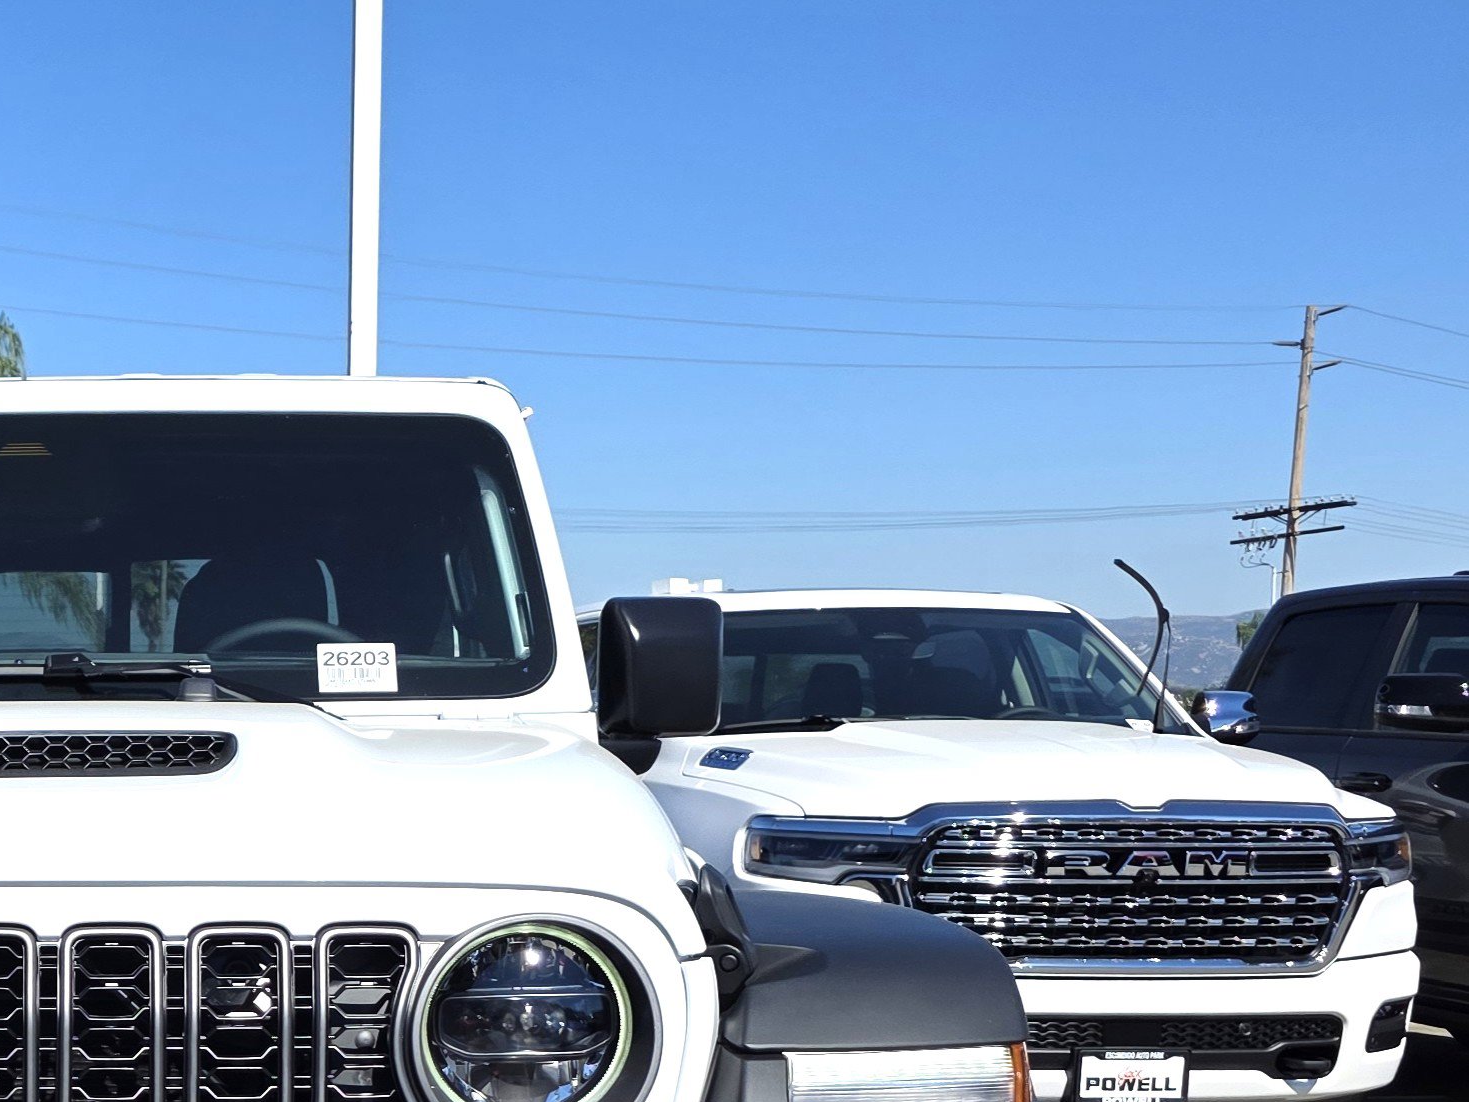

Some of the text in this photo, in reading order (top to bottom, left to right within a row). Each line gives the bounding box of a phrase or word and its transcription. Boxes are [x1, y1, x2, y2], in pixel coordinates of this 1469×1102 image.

[322, 651, 390, 666] 26203
[1045, 850, 1248, 877] RAM
[1086, 1077, 1177, 1092] POWELL
